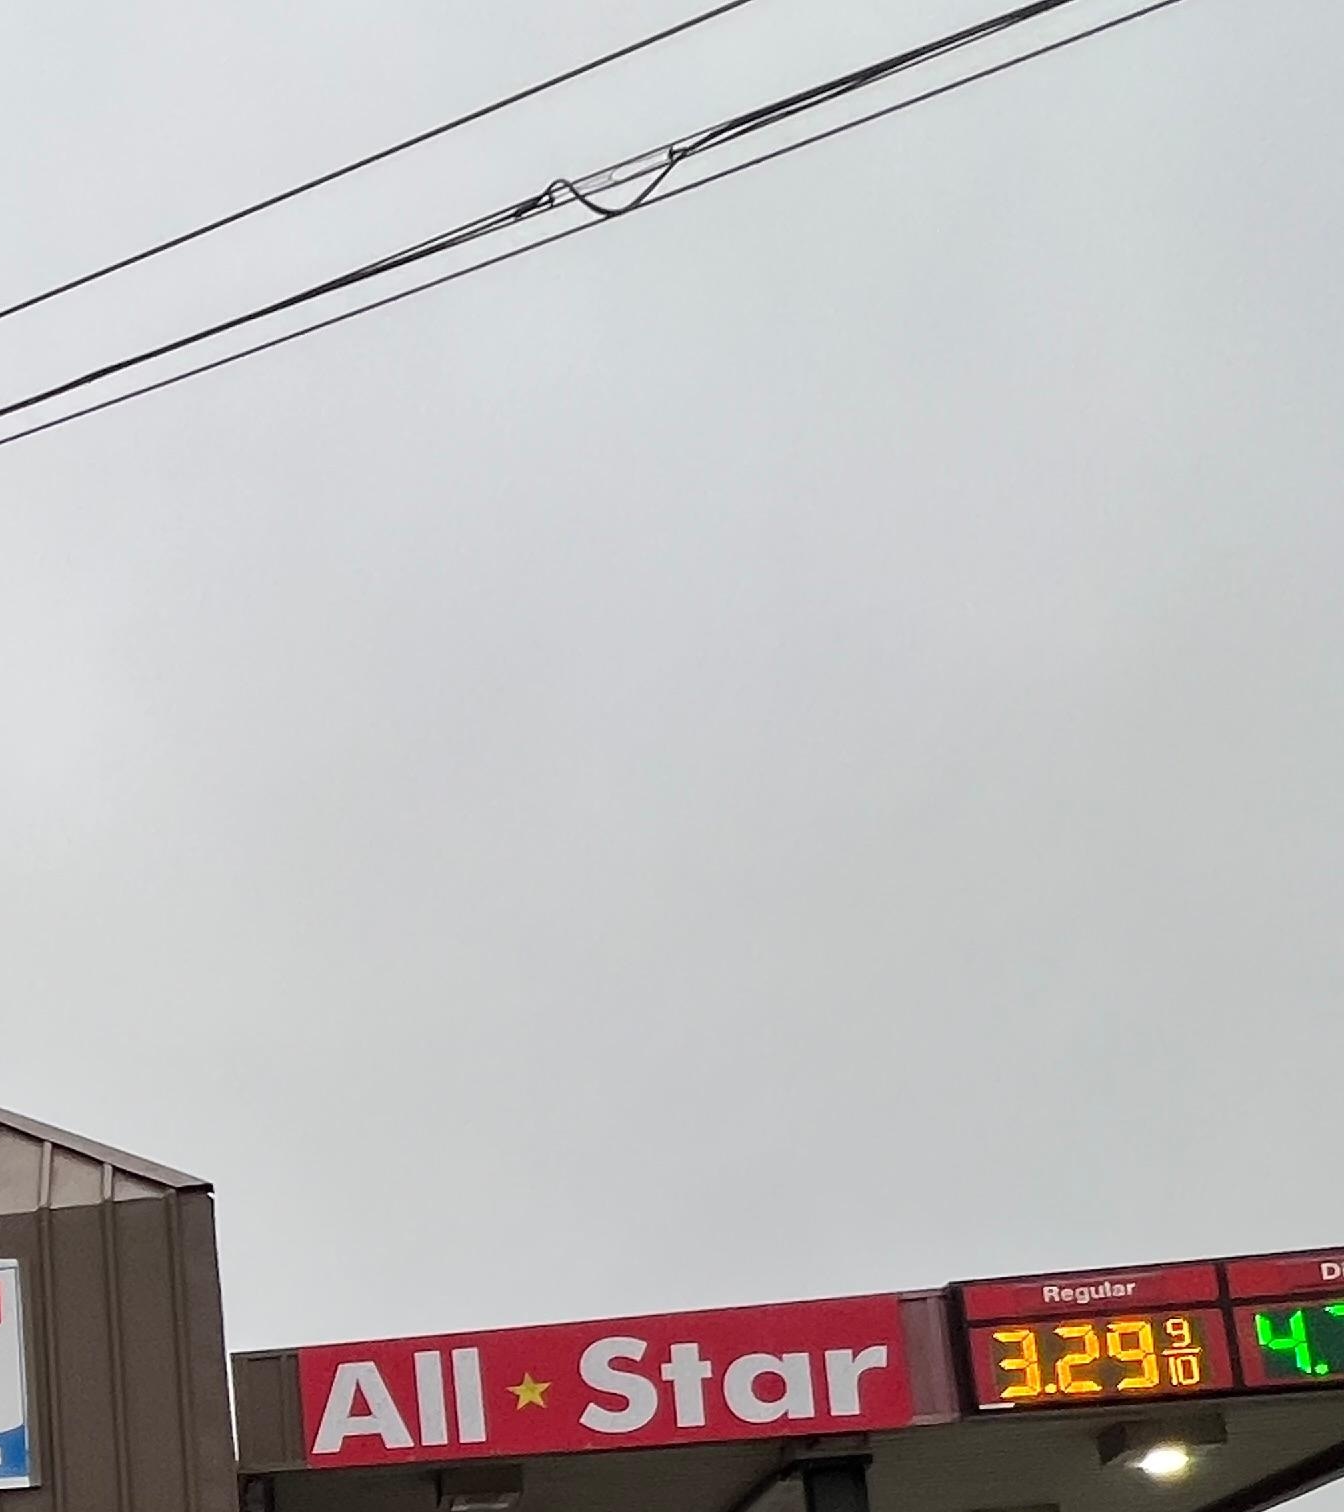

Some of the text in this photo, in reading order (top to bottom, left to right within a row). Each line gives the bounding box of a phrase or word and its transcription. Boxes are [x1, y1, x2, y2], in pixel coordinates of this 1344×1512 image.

[1042, 1281, 1136, 1304] Regular
[1320, 1261, 1344, 1281] D
[993, 1316, 1160, 1399] 3.29
[312, 1336, 888, 1455] All Star
